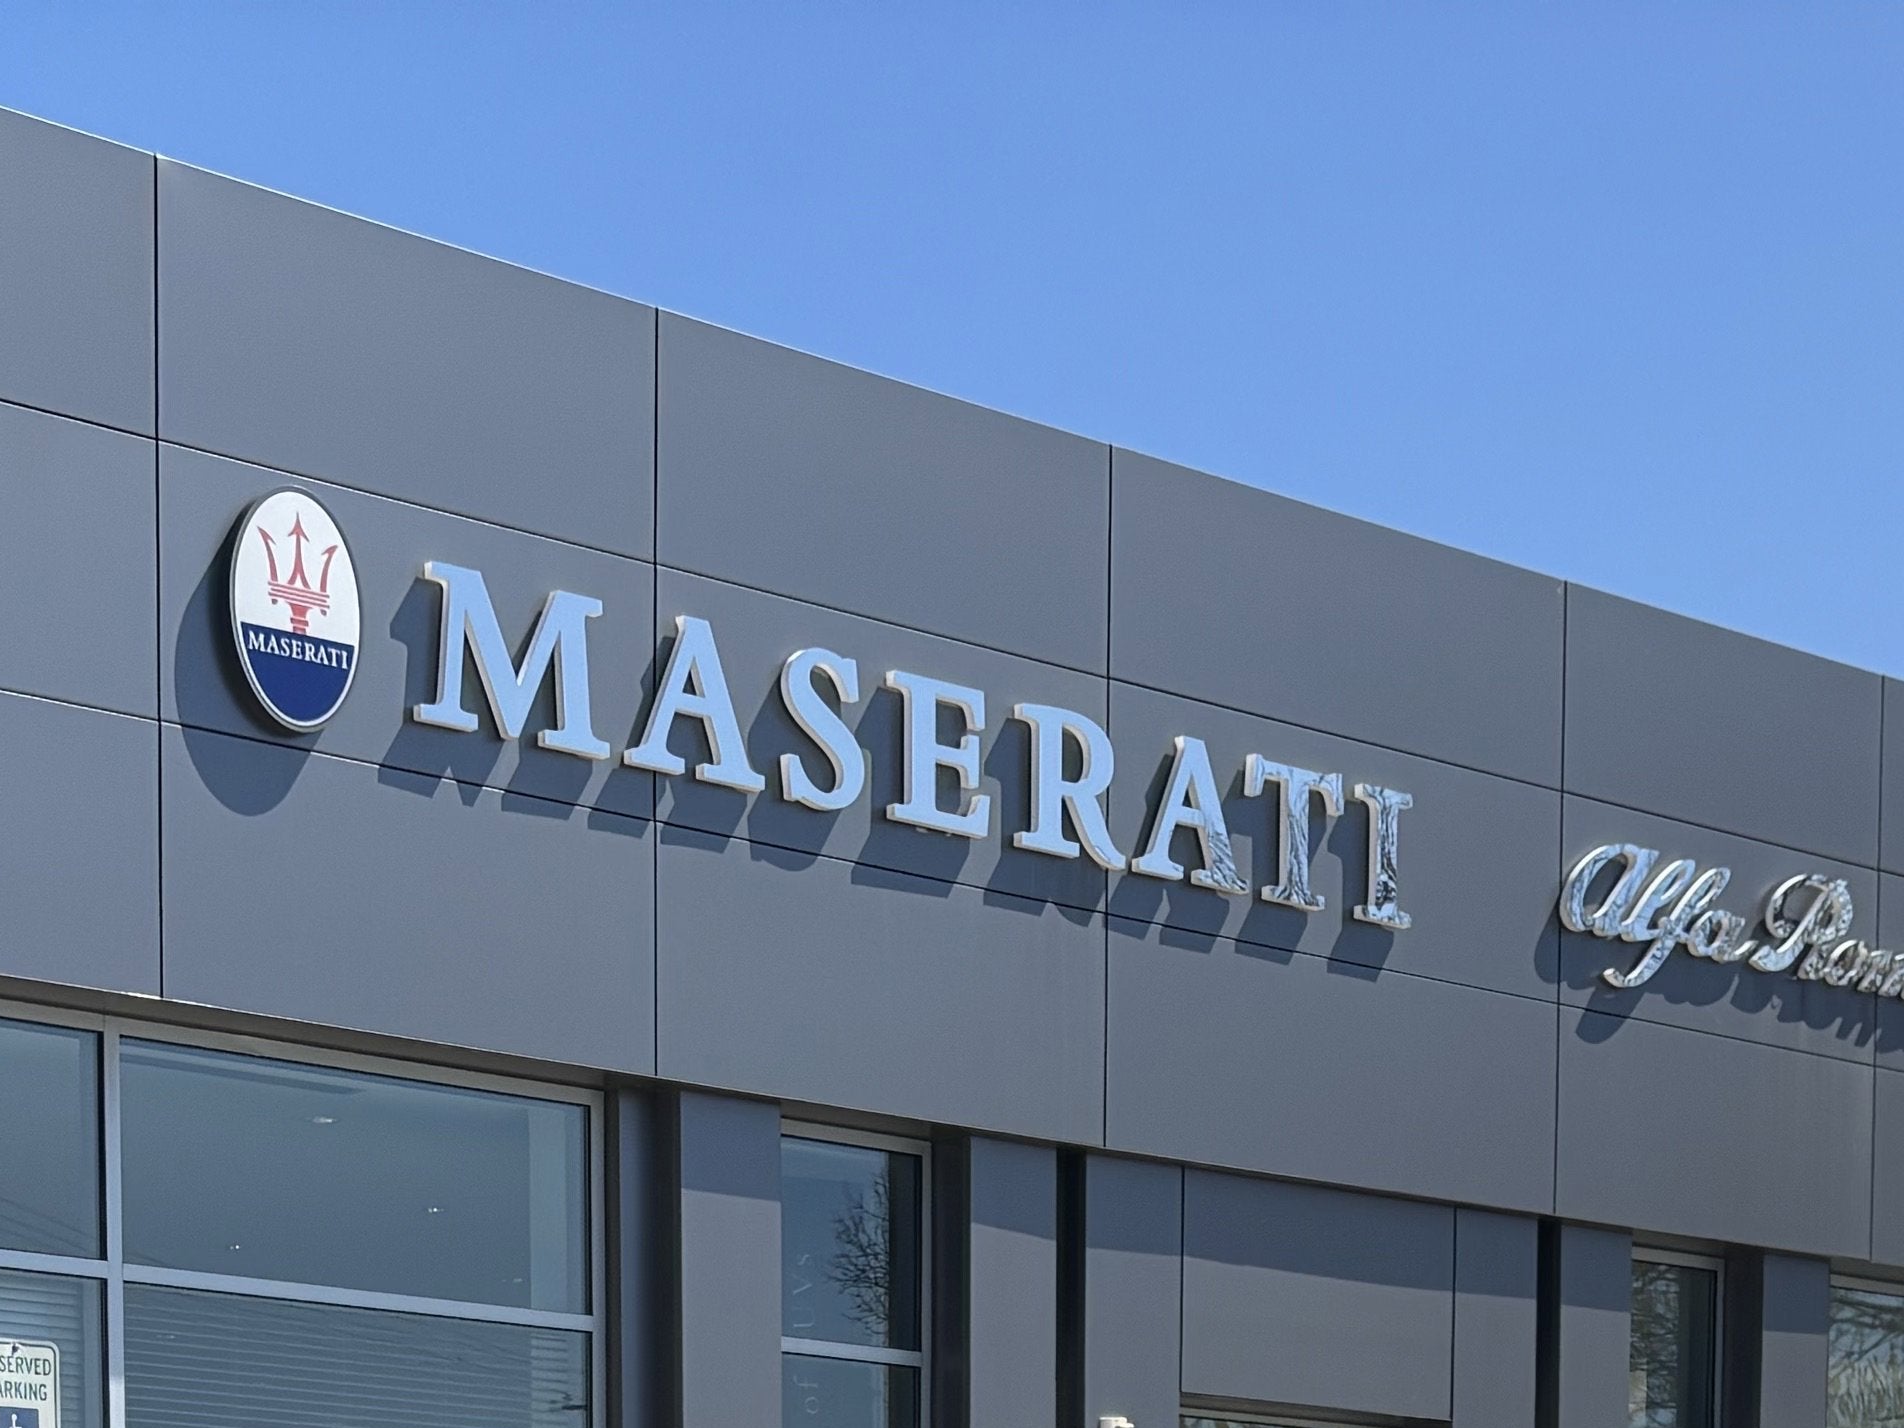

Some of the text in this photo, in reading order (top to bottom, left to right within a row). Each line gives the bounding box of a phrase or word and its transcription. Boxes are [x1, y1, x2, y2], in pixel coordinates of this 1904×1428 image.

[248, 630, 349, 670] MASERATI
[412, 560, 1414, 930] MASERATI
[1559, 843, 1758, 988] Alfa
